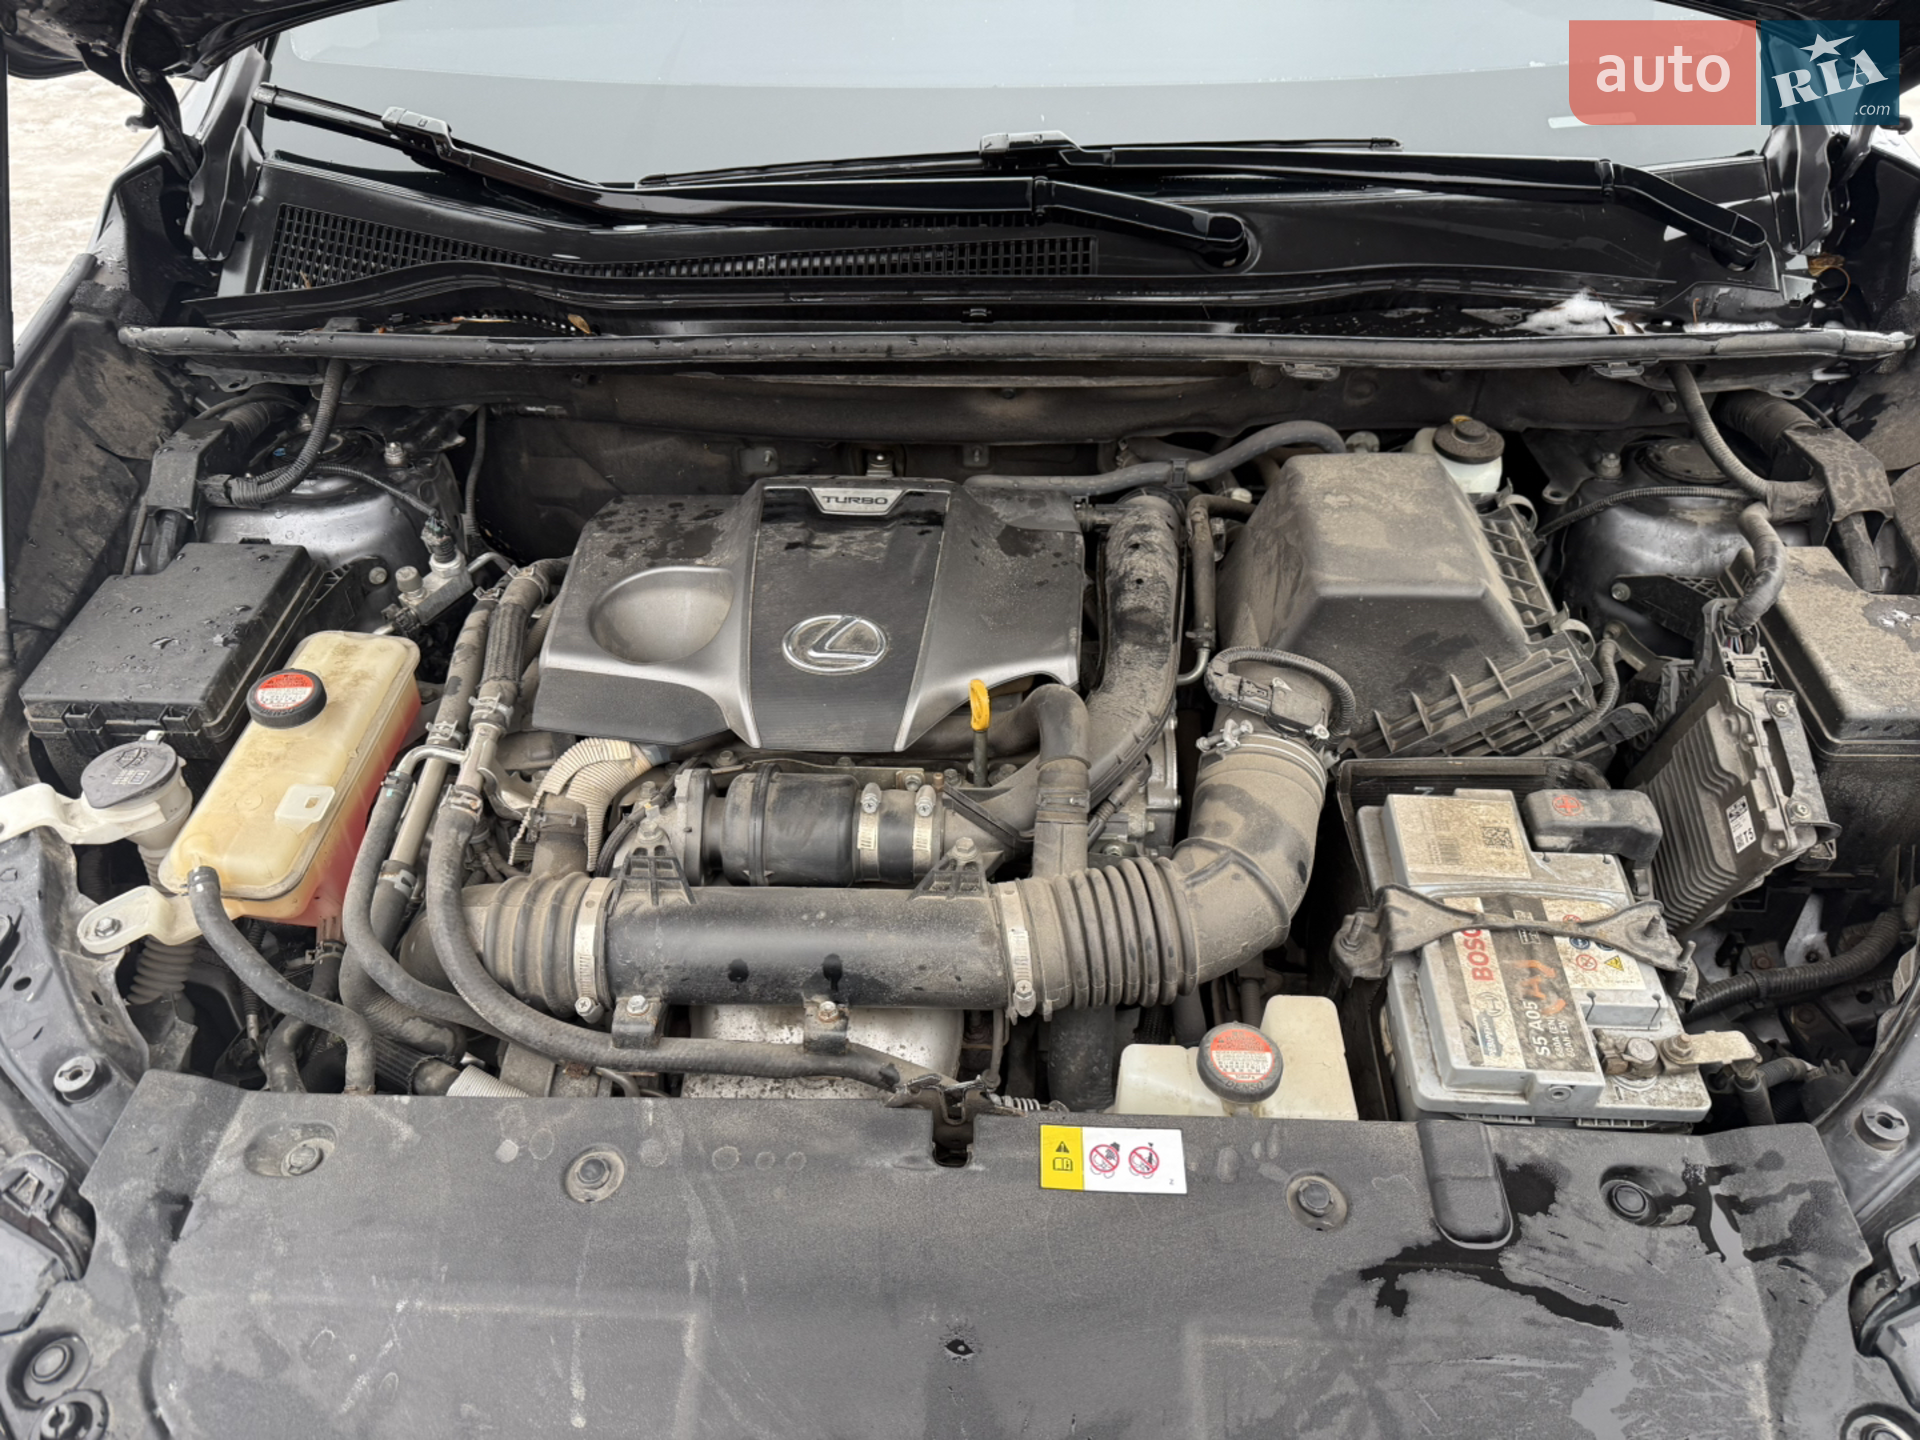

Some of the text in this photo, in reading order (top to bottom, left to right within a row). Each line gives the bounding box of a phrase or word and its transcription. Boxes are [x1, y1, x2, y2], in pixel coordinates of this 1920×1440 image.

[821, 496, 888, 505] TURBO
[1462, 929, 1495, 981] BOSC
[1522, 1000, 1551, 1057] S5 A05
